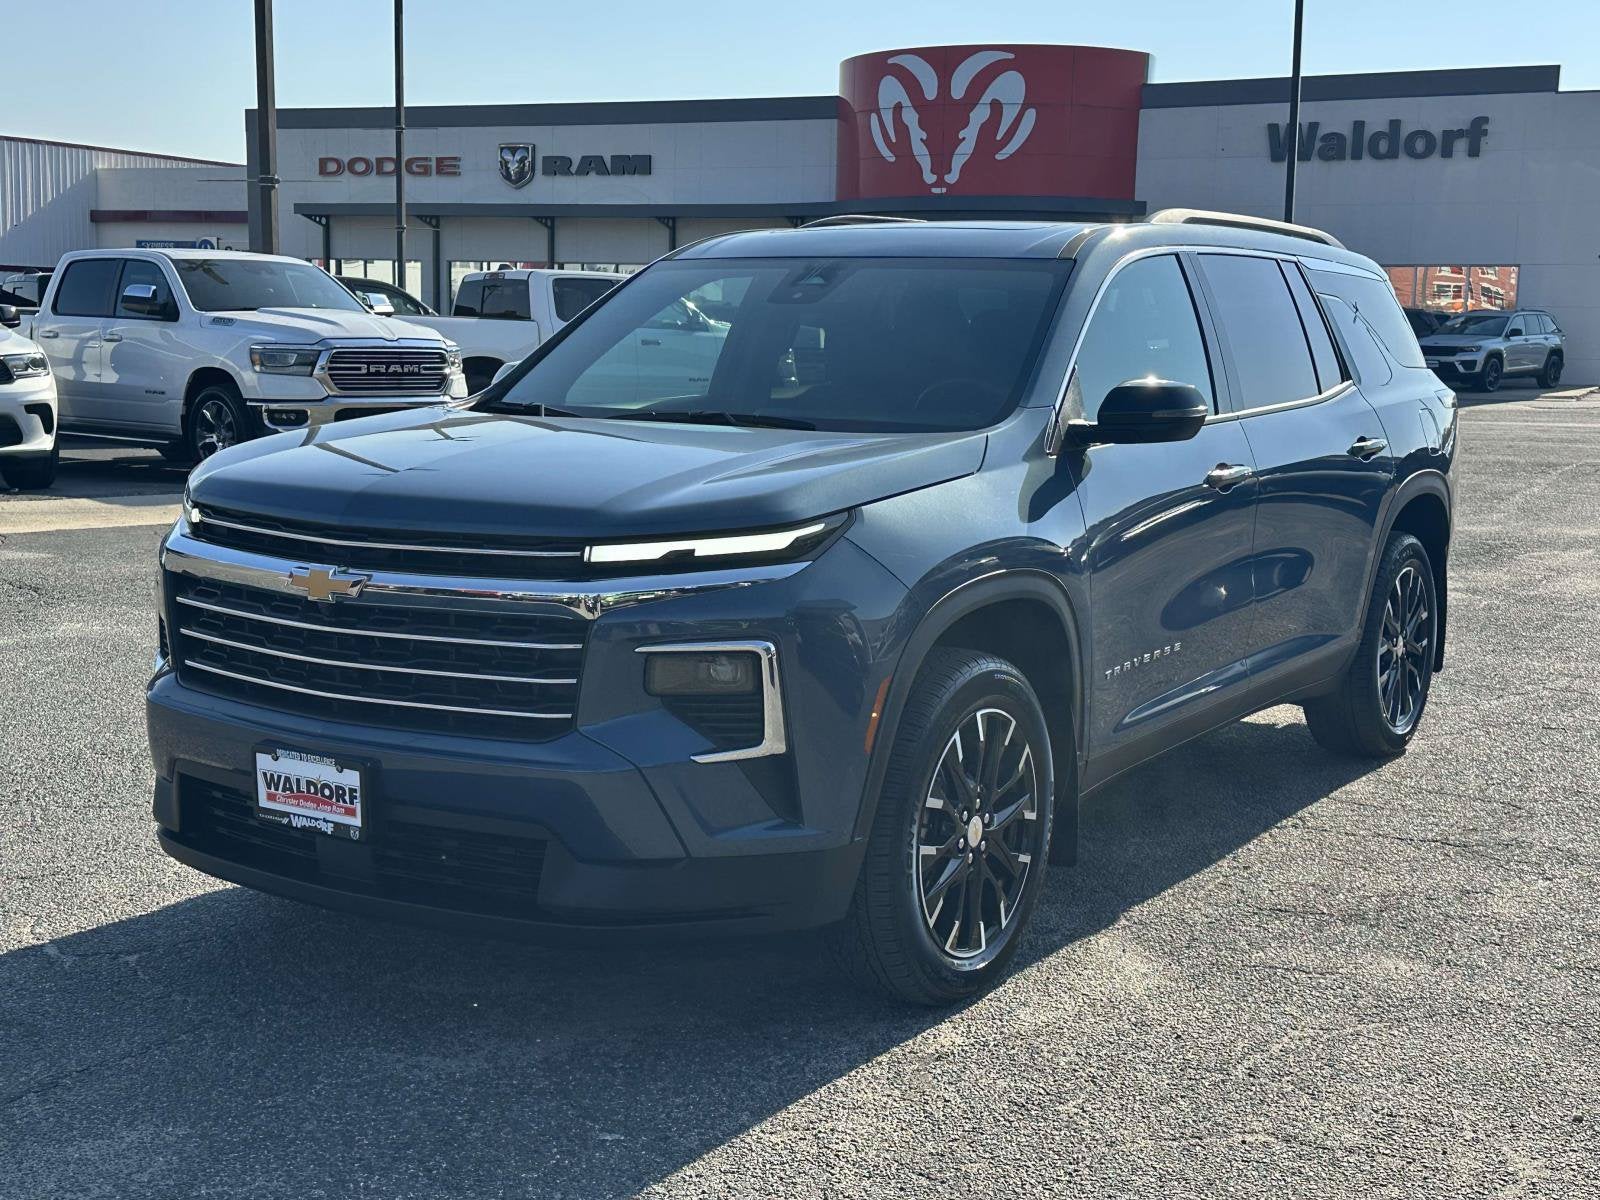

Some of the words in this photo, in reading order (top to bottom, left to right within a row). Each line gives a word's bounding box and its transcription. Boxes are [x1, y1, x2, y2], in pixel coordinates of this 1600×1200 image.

[1267, 115, 1490, 163] Waldorf
[318, 156, 462, 177] DODGE
[541, 155, 652, 176] RAM
[369, 364, 419, 373] RAM
[1105, 642, 1181, 680] TRAVERSE
[301, 753, 307, 762] TO
[307, 754, 336, 767] EXCELLENCE
[262, 771, 358, 806] WALDORF
[276, 794, 299, 806] Chrysler
[299, 799, 317, 809] Dodge
[317, 803, 331, 811] Jeep
[332, 806, 345, 814] Ram
[289, 813, 334, 835] WALDORF
